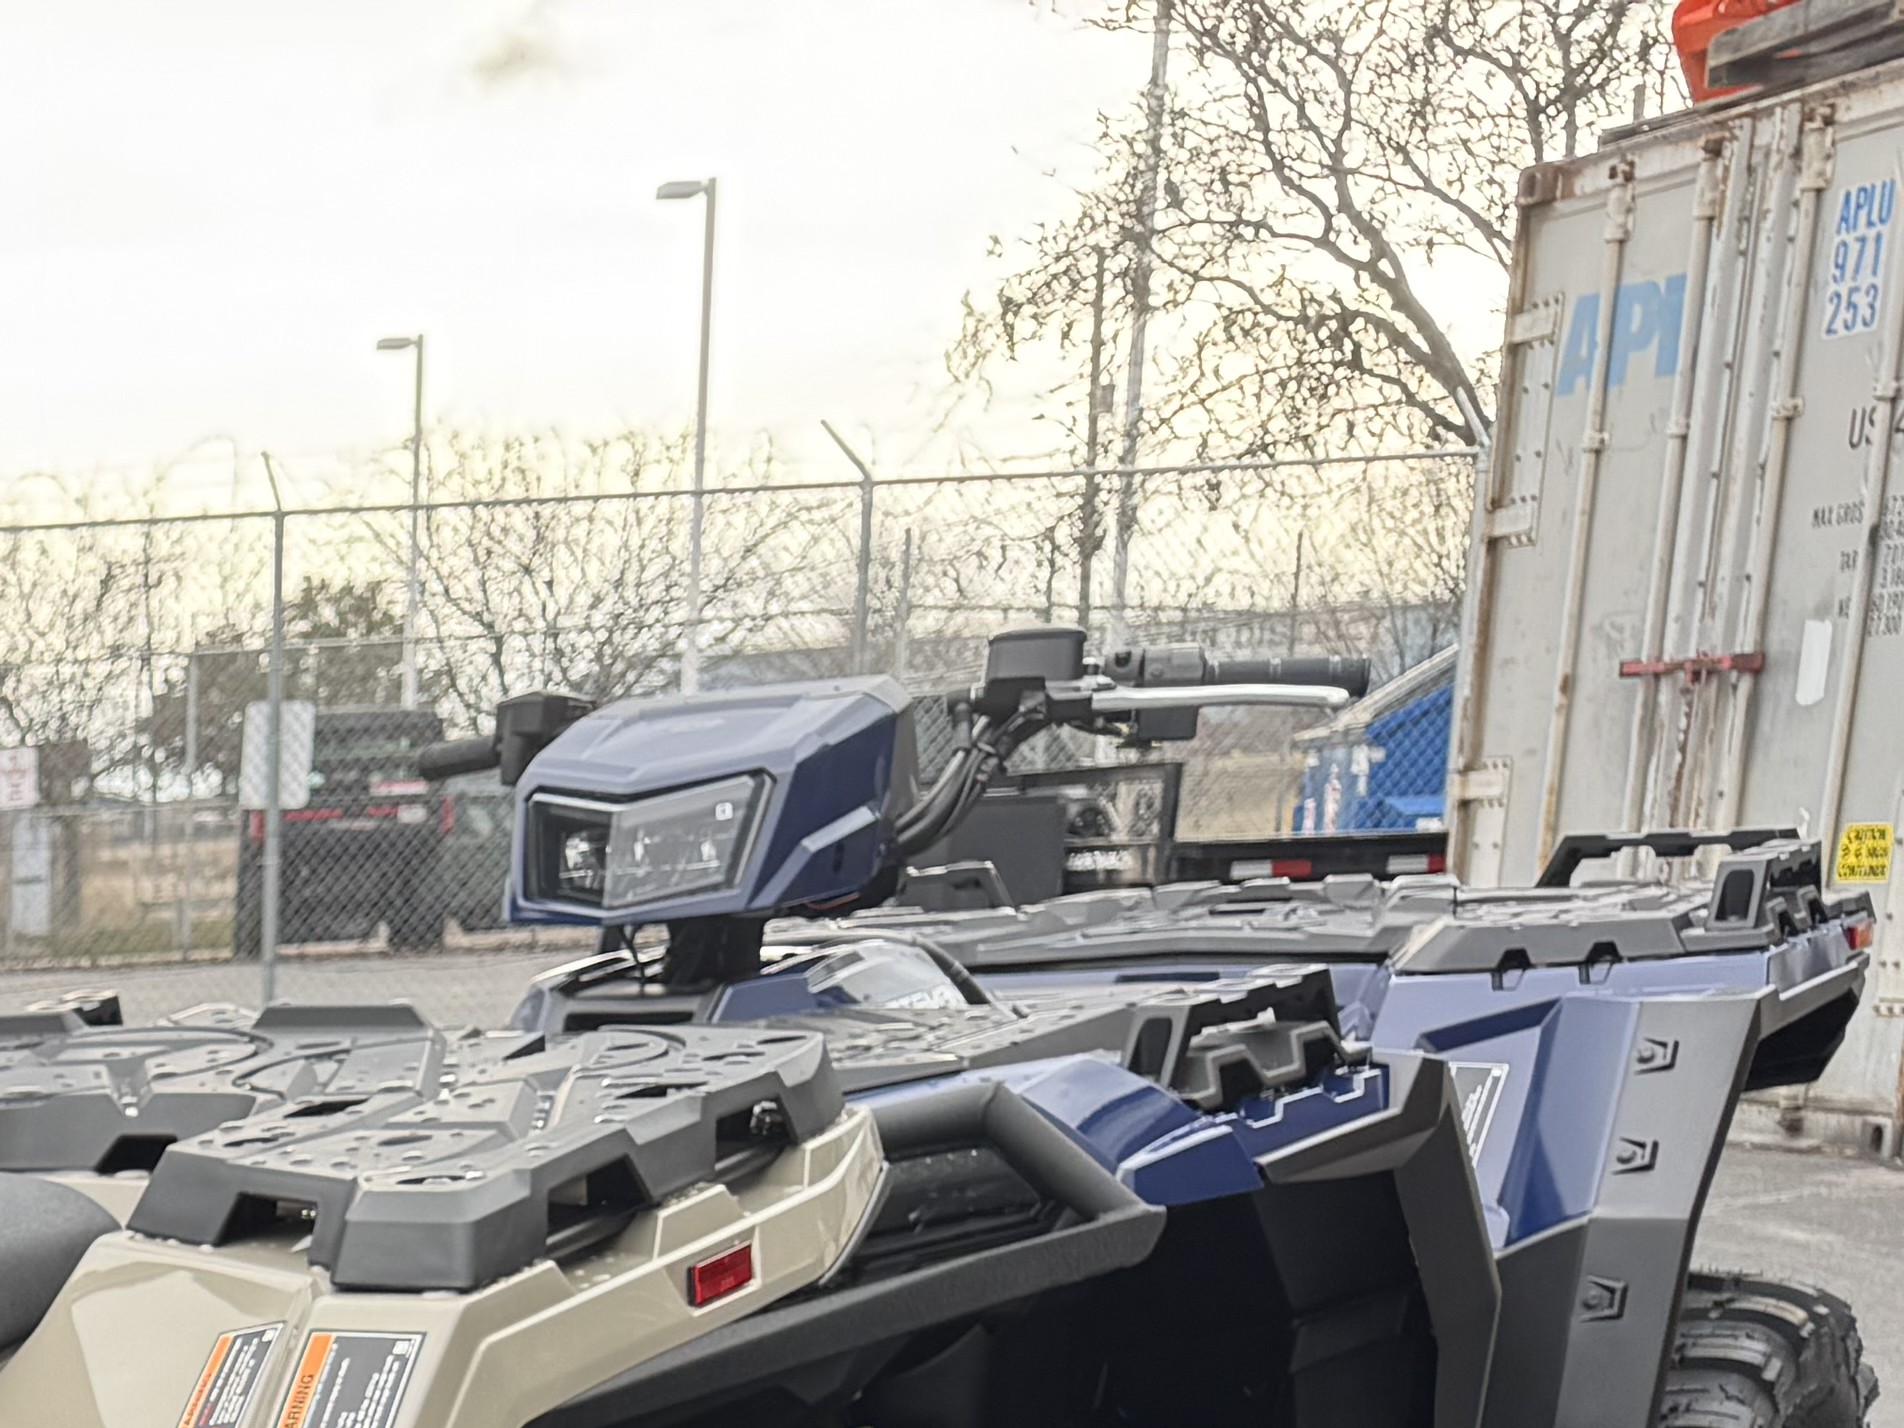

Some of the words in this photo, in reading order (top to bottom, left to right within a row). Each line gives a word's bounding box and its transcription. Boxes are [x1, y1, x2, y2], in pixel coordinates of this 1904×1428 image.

[1835, 178, 1896, 236] APLU
[1832, 231, 1884, 285] 971
[1825, 283, 1879, 337] 253
